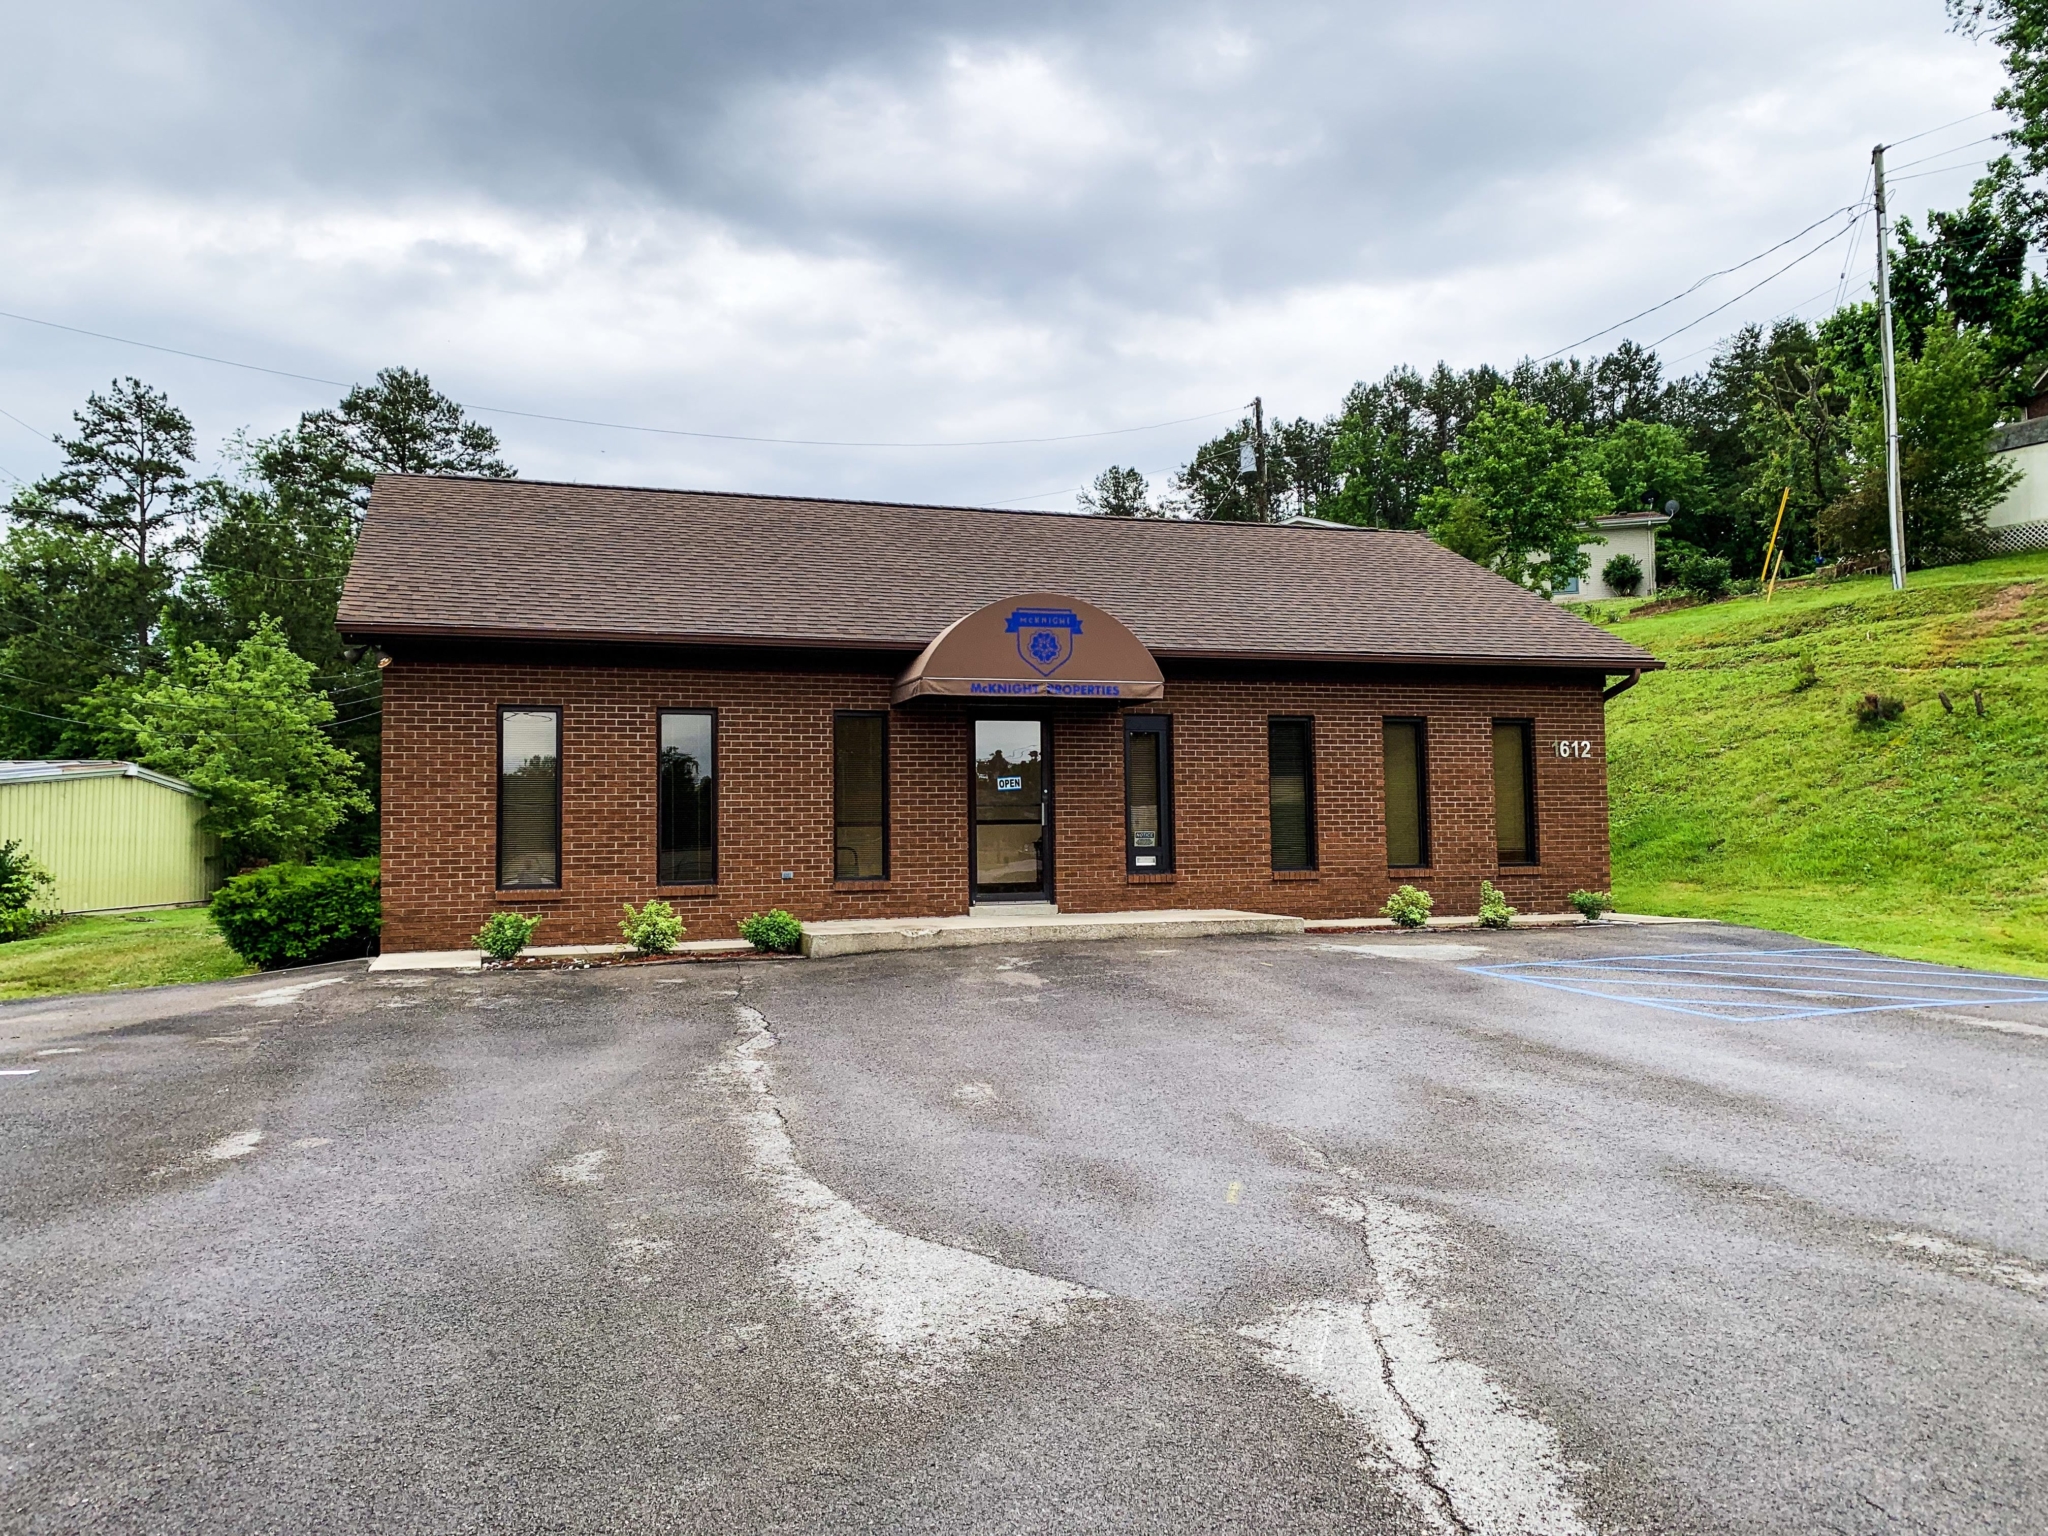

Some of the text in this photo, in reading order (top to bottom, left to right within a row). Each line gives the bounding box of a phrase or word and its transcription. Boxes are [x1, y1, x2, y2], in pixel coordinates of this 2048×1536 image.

[970, 683, 1120, 696] McKNIGHT PROPERTIES
[999, 779, 1020, 788] OPEN
